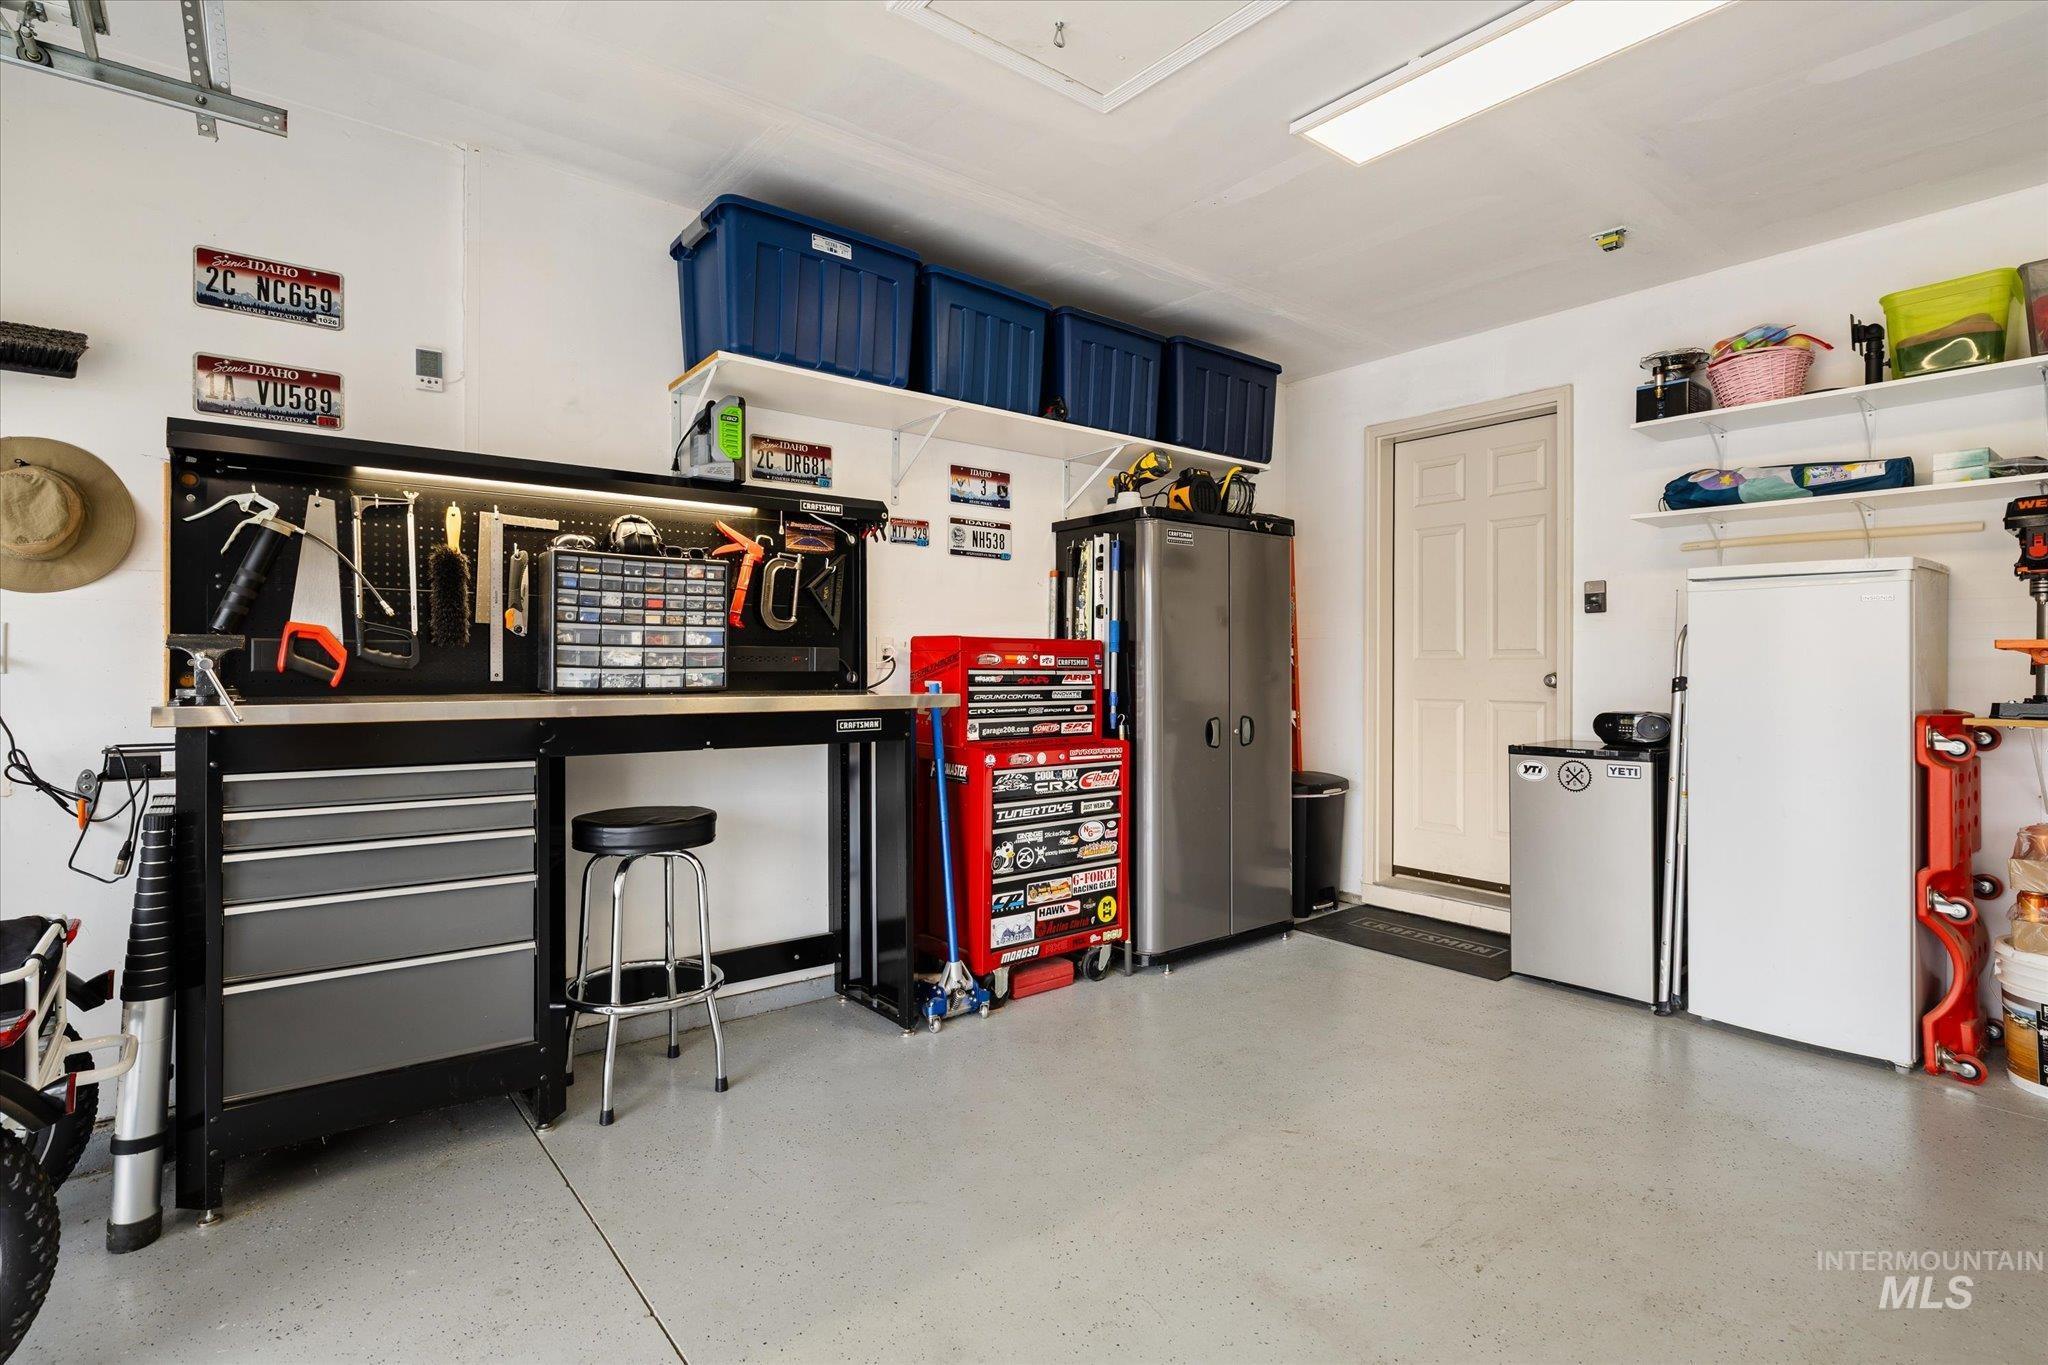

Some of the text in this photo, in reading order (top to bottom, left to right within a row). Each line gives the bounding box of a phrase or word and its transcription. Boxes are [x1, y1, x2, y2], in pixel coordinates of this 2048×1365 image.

[211, 255, 298, 278] Scenic IDAHO
[206, 266, 332, 313] 2C NC659
[232, 303, 309, 323] FAMOUS POTATOES
[212, 361, 299, 380] Scenic IDAHO
[205, 373, 332, 414] 1A VU589
[233, 410, 309, 425] FAMOUS POTATOES
[780, 441, 808, 453] IDAHO
[756, 449, 827, 477] 2C DR681
[969, 469, 992, 479] IDAHO
[980, 479, 987, 496] 3
[802, 502, 841, 513] CRAFTSMAN
[965, 520, 997, 528] IDAHO
[912, 526, 928, 541] 329
[972, 530, 1005, 550] NH538
[1168, 530, 1192, 538] CRAFTSMAN
[1058, 659, 1088, 667] CRAFTSMAN
[839, 720, 879, 730] CRAFTSMAN
[981, 726, 1030, 736] garage208.com
[1064, 721, 1091, 729] SPC
[1034, 768, 1078, 781] COOL BOY
[1609, 766, 1639, 776] YETI
[1033, 780, 1079, 792] CRX
[996, 802, 1074, 820] TUNERTOYS
[1083, 803, 1092, 811] JUST
[1044, 830, 1071, 838] StickerShop
[1072, 868, 1116, 886] G-FORCE
[1073, 880, 1116, 894] RACING GEAR
[1039, 905, 1066, 918] HAWK
[1362, 919, 1494, 953] CRAFTSMAN
[1001, 945, 1040, 963] MOROSO
